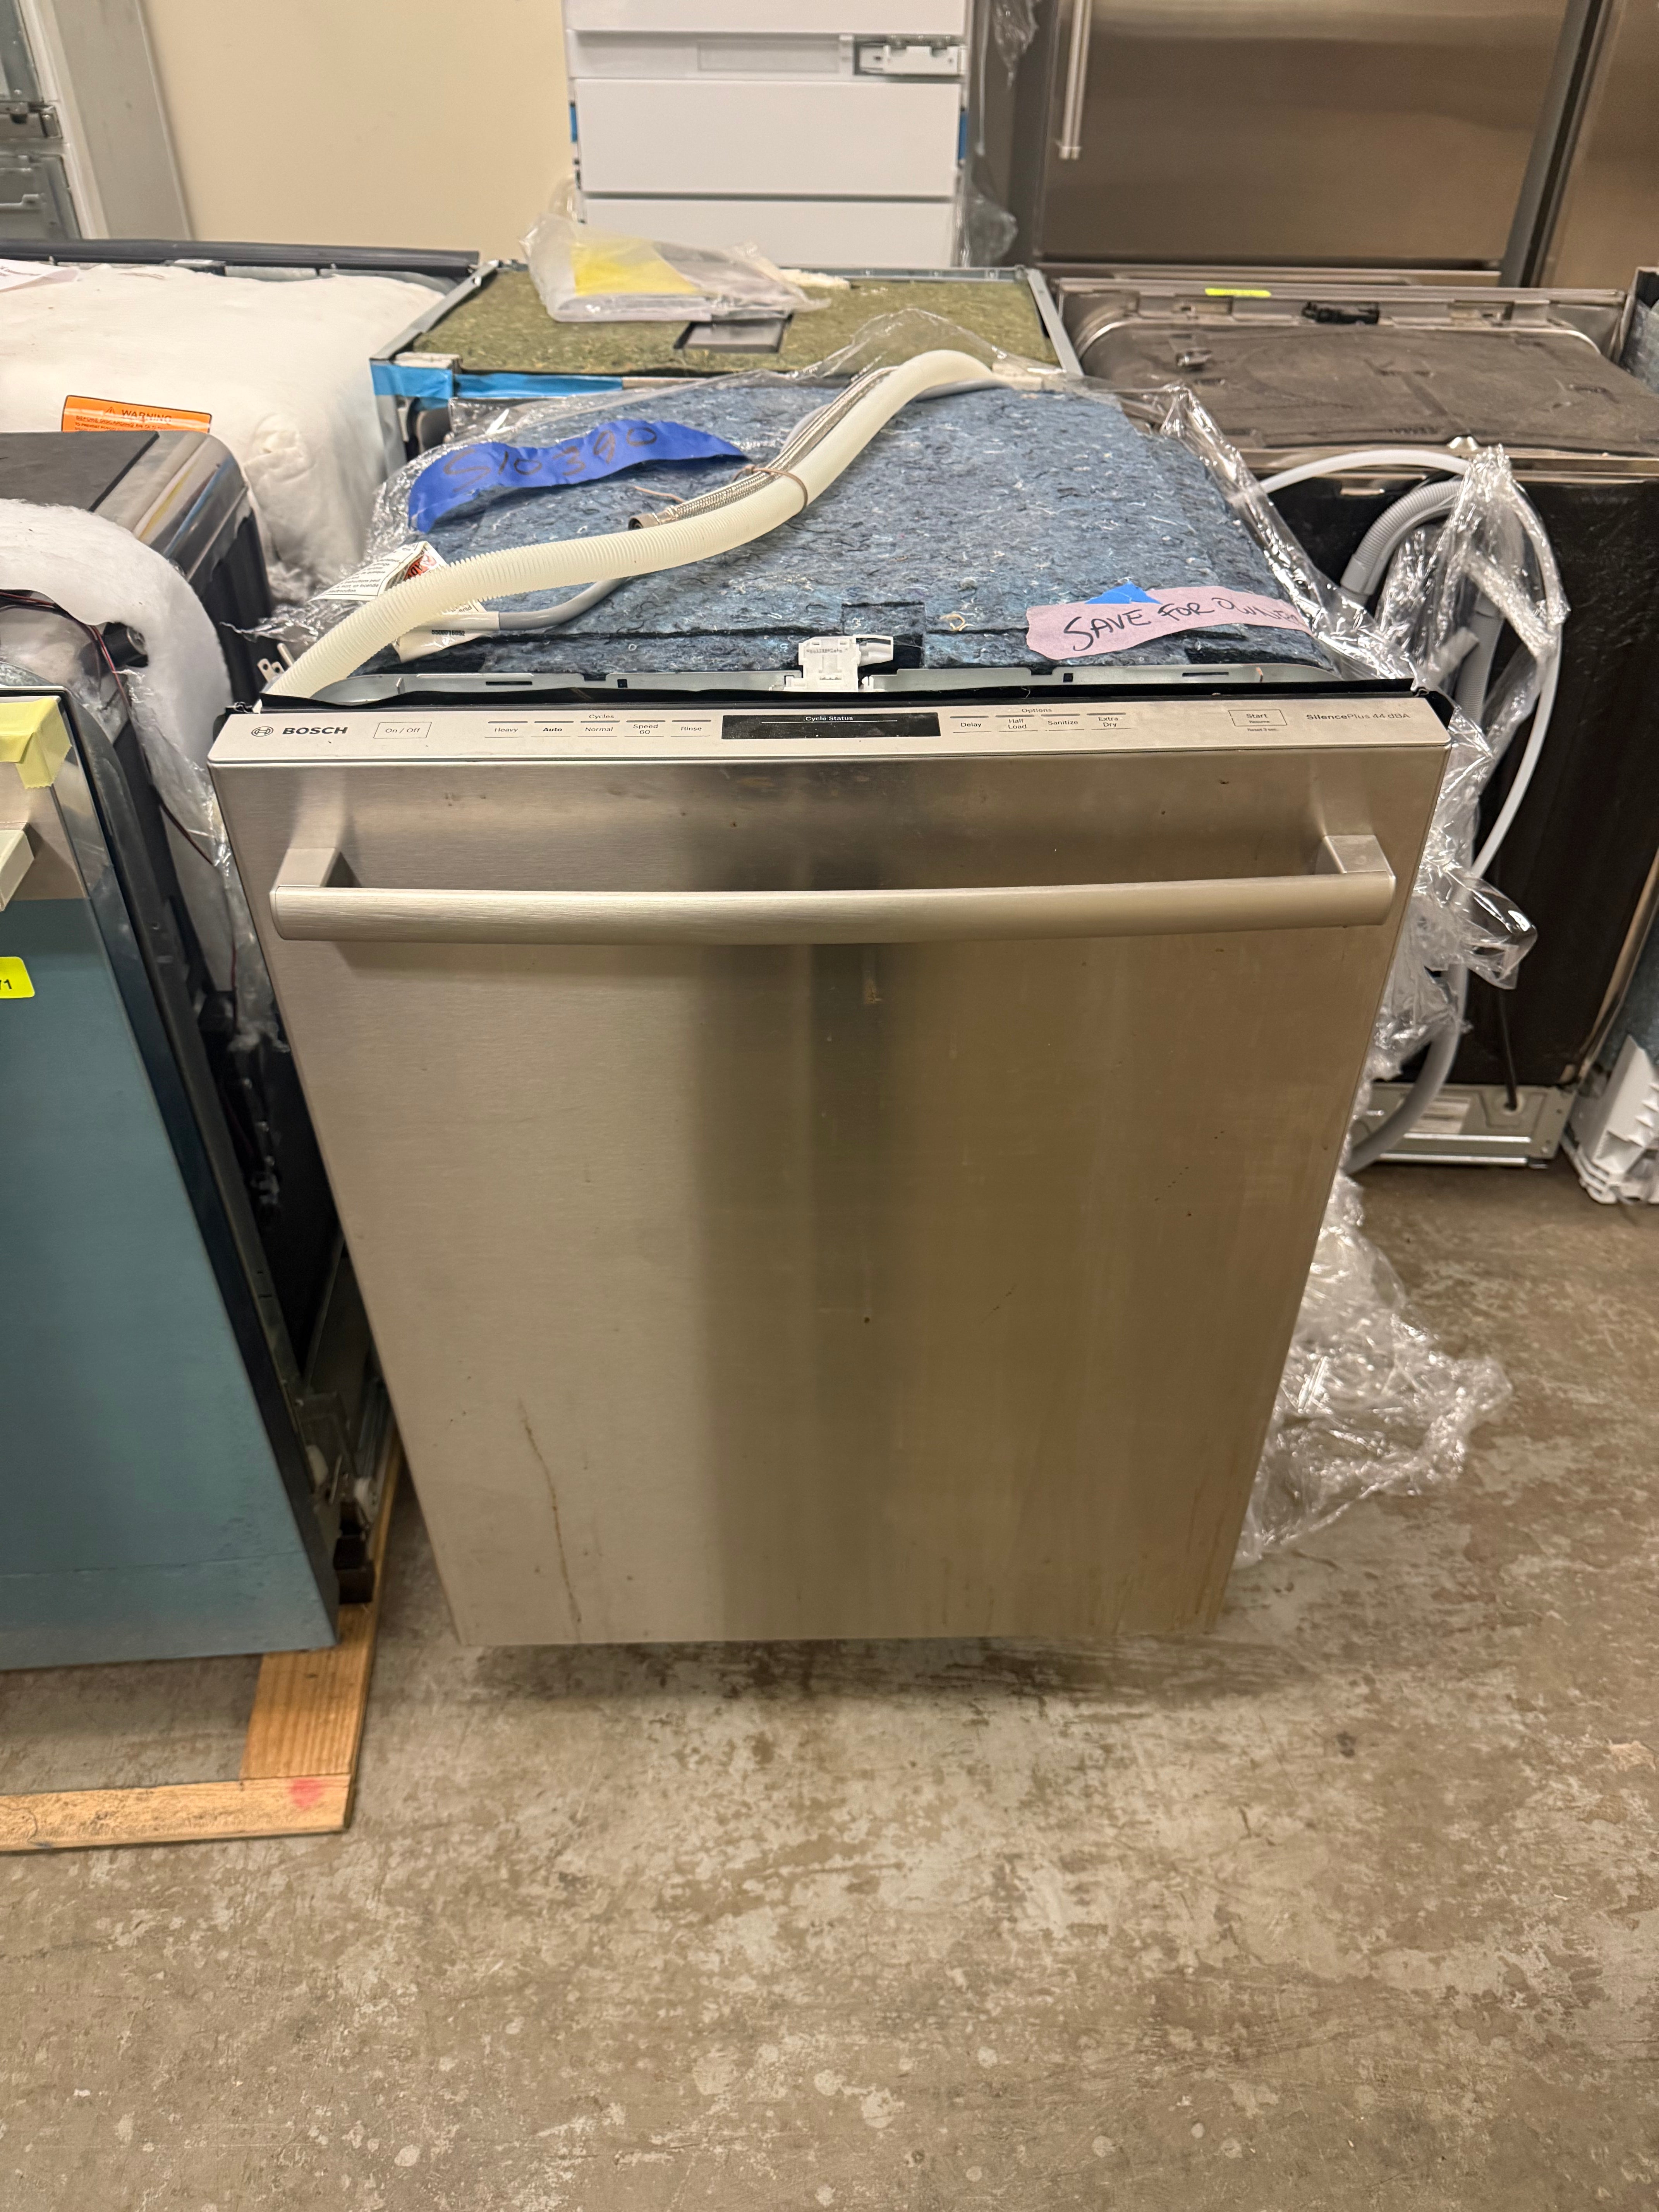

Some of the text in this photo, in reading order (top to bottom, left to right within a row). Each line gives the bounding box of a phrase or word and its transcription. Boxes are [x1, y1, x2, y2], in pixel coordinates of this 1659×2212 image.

[121, 409, 172, 422] WARNING
[1063, 609, 1151, 651] SAVE
[1158, 602, 1215, 622] FOR
